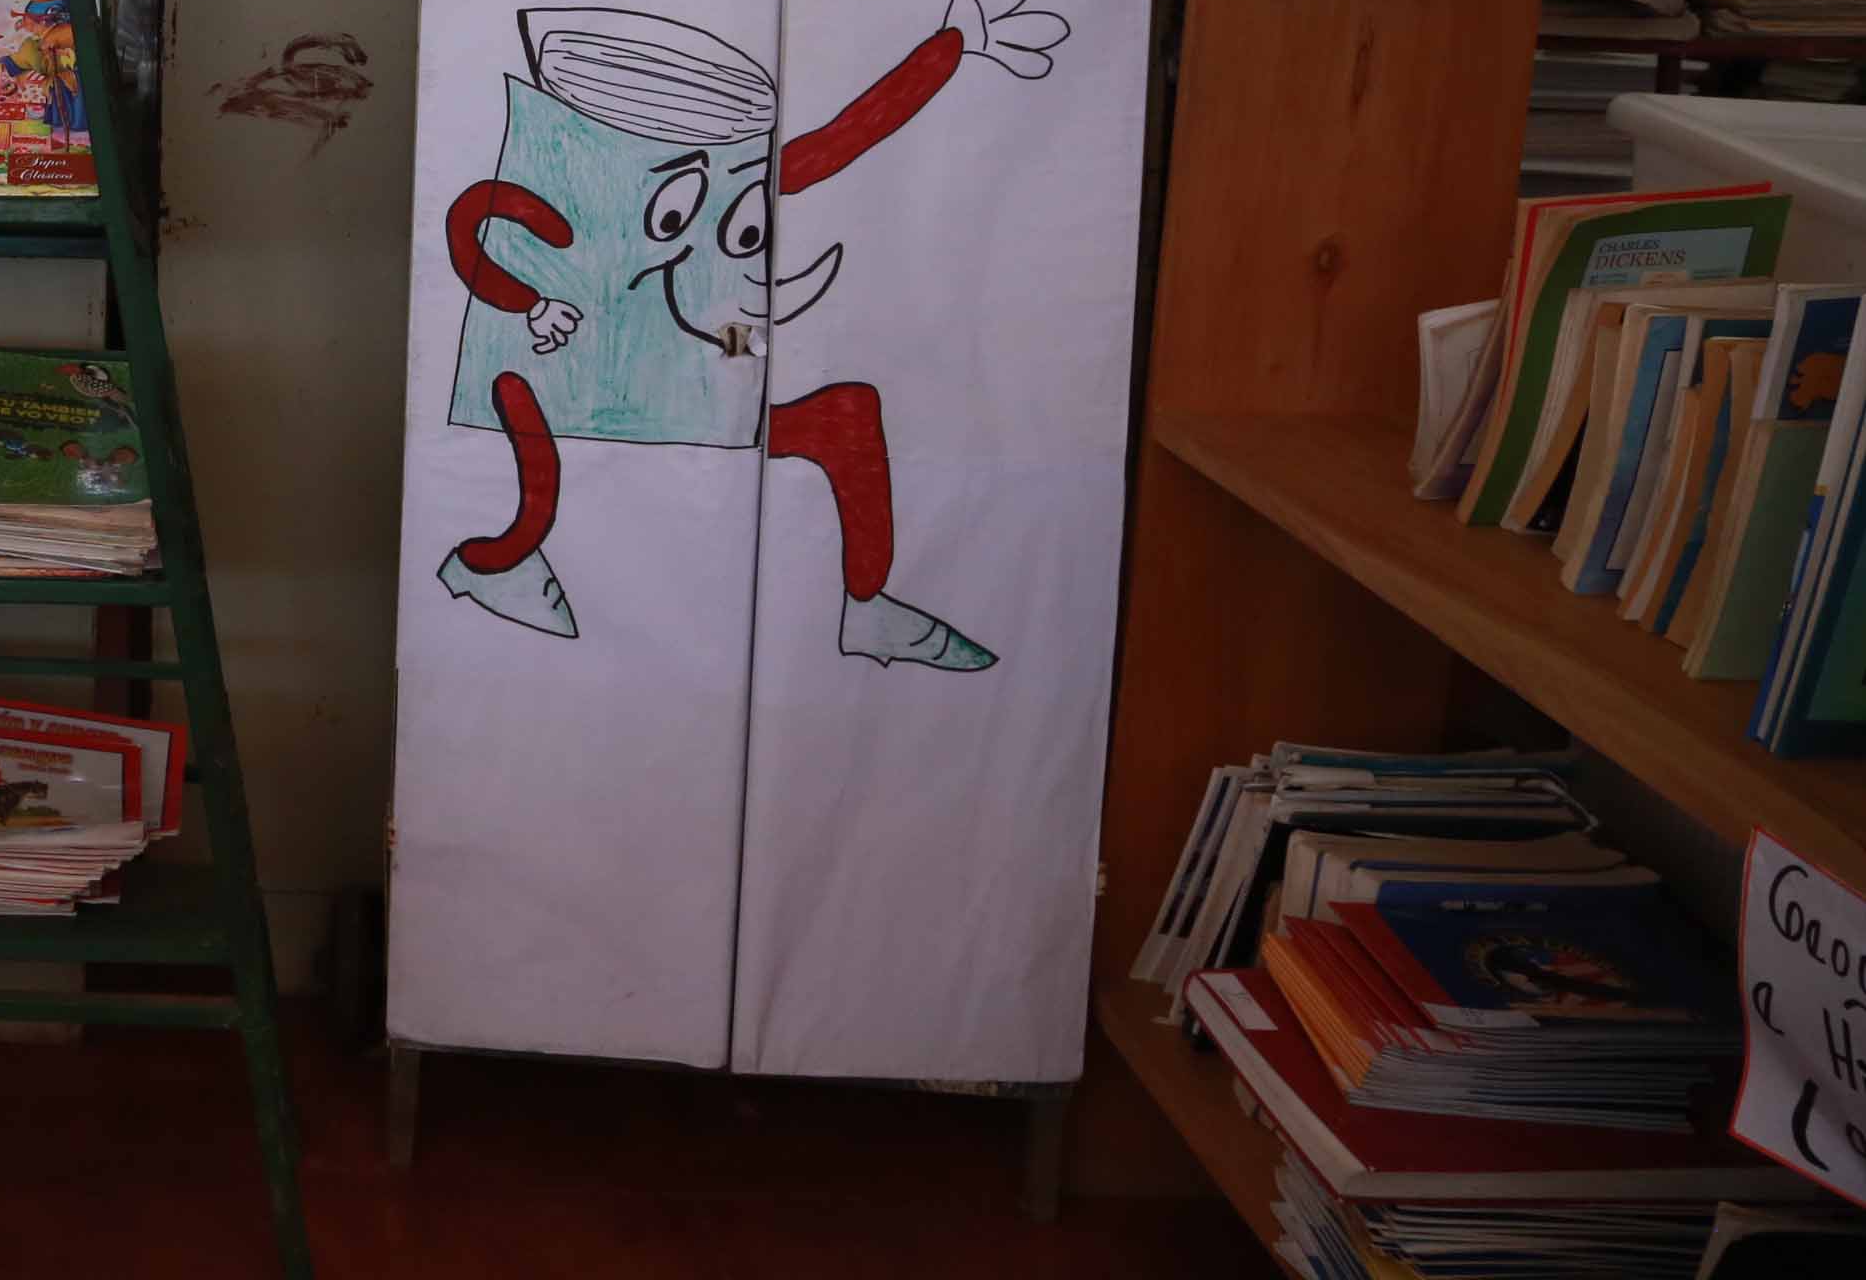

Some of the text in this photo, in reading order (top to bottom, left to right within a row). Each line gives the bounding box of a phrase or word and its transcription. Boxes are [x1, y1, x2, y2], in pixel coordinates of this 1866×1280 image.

[1599, 238, 1662, 254] CHARLES
[1595, 249, 1687, 271] DICKENS
[16, 406, 43, 419] YO
